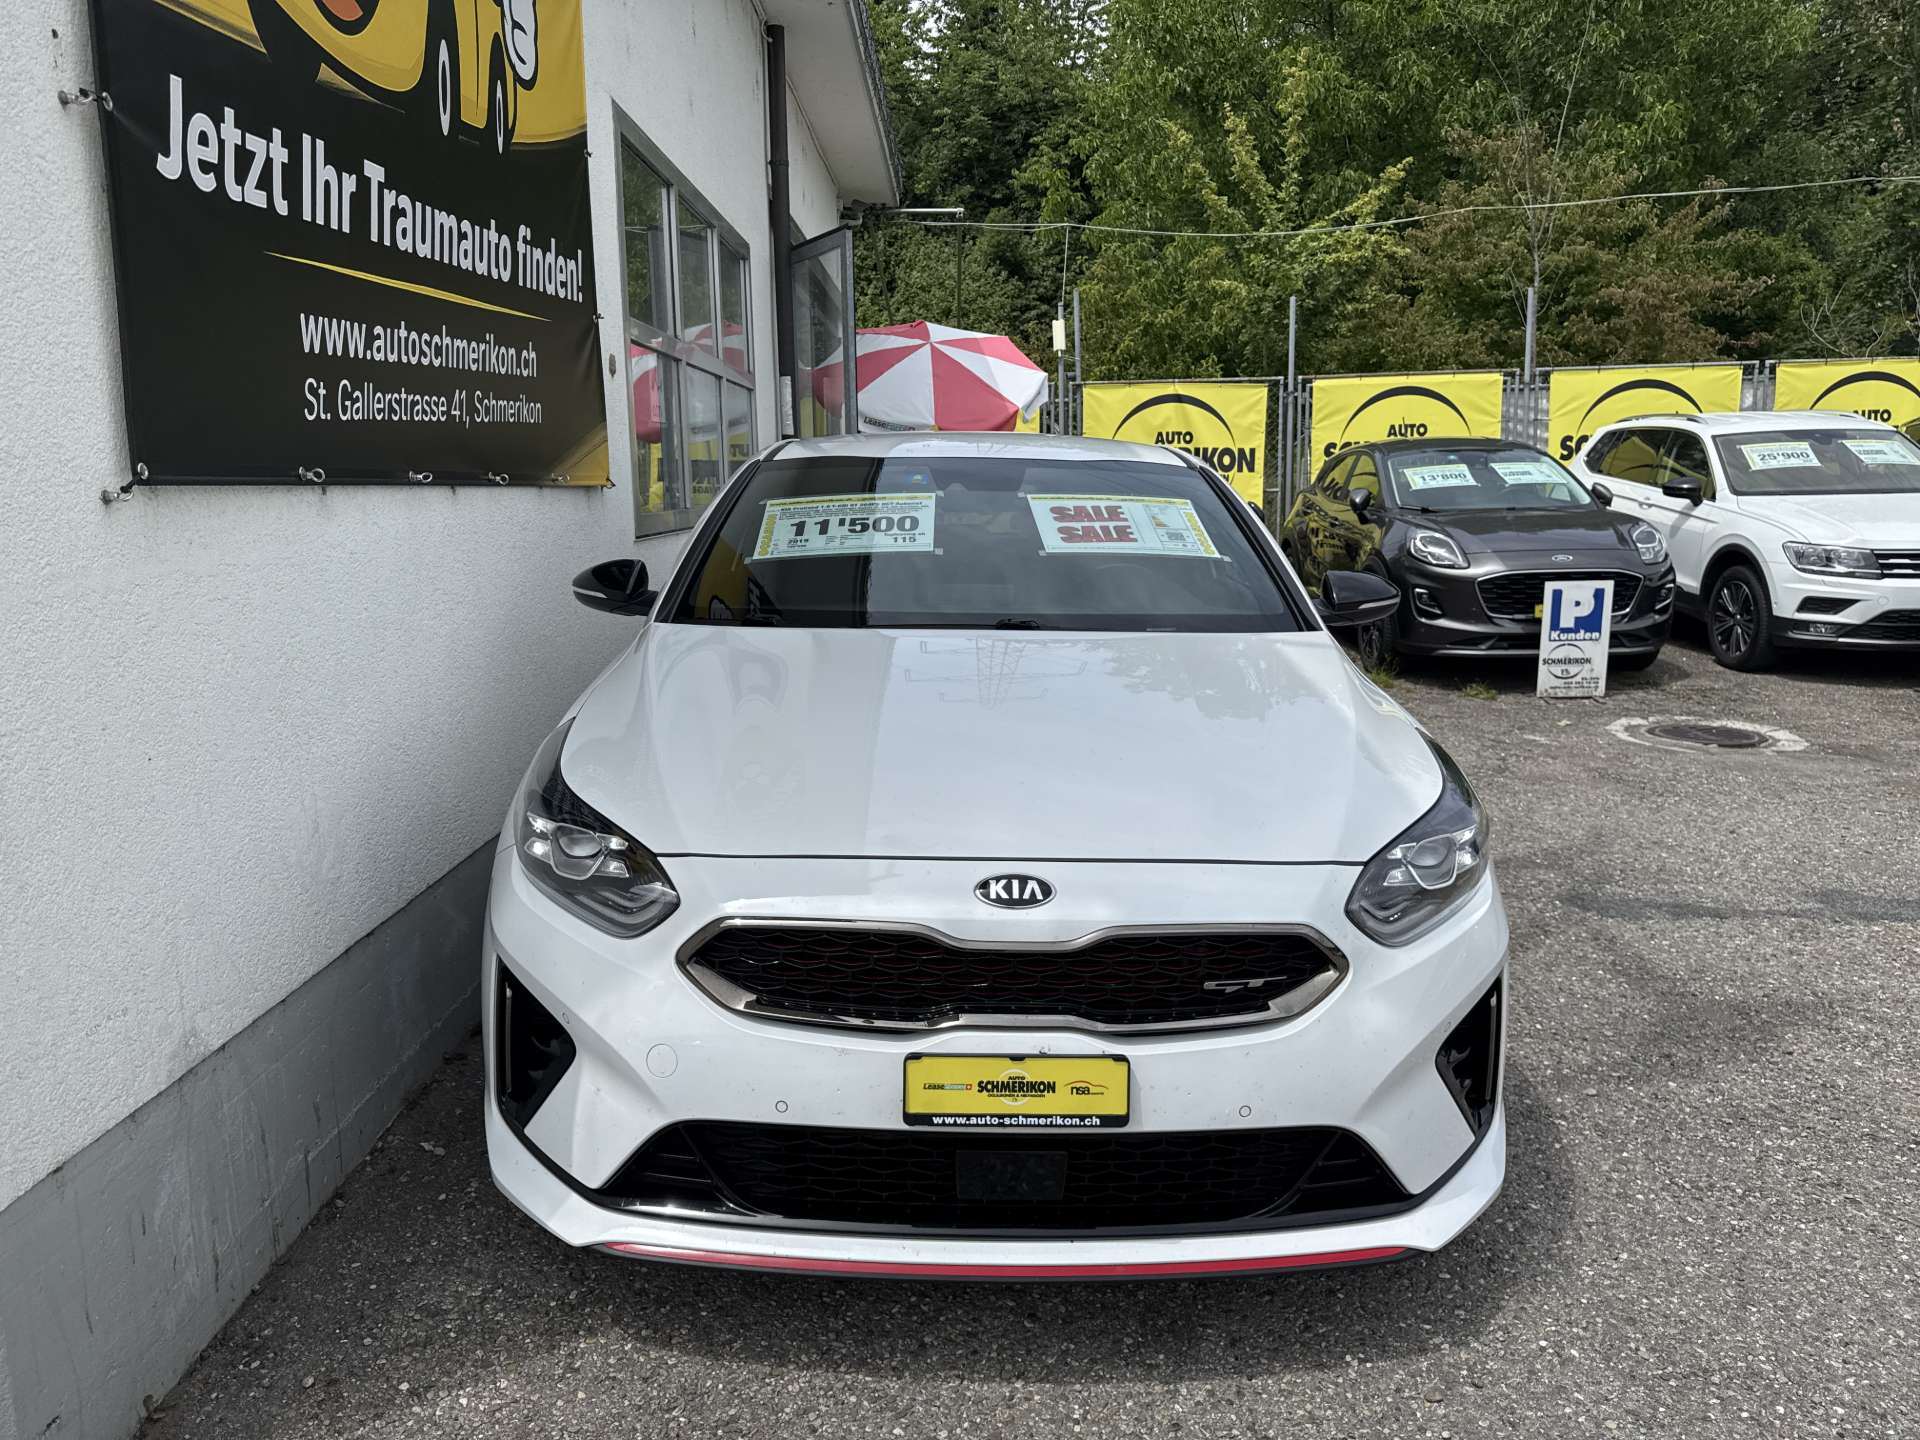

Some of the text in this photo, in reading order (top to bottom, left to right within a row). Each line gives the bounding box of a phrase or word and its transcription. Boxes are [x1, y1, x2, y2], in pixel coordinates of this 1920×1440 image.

[156, 74, 583, 303] Jetzt Ihr Traumauto finden!
[300, 313, 538, 379] www.autoschmerikon.ch
[303, 378, 542, 430] St. Gallerstrasse 41, Schmerikon
[1154, 431, 1194, 445] AUTO
[1387, 423, 1428, 438] AUTO
[1758, 452, 1810, 461] 25'900
[1050, 505, 1128, 523] SALE
[790, 515, 920, 537] 11'500
[1057, 525, 1138, 544] SALE
[1560, 588, 1595, 629] P
[1550, 630, 1601, 641] Kunden
[1542, 657, 1592, 666] SCHMERIKON
[989, 879, 1044, 900] KIA
[977, 1080, 1056, 1094] SCHMERIKON
[1070, 1085, 1091, 1096] nsa
[932, 1115, 1101, 1127] www.auto-schmerikon.ch
